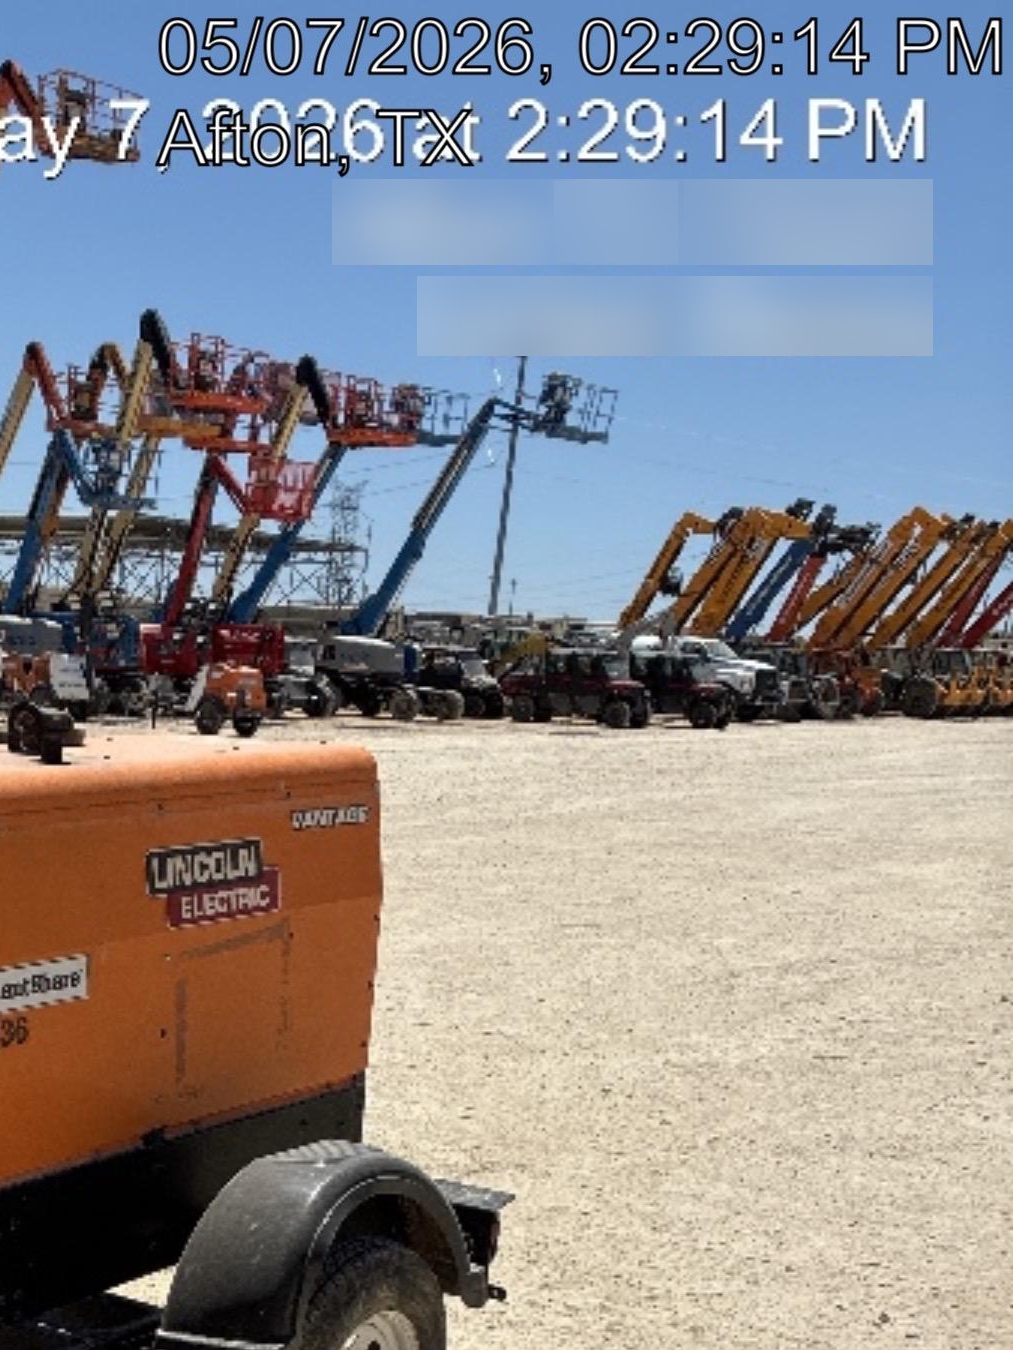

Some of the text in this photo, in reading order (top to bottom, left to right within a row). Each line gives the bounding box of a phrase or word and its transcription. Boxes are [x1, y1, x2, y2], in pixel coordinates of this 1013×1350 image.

[292, 806, 369, 829] VANTAGE
[151, 845, 256, 889] LINCOLN
[181, 885, 270, 919] ELECTRIC
